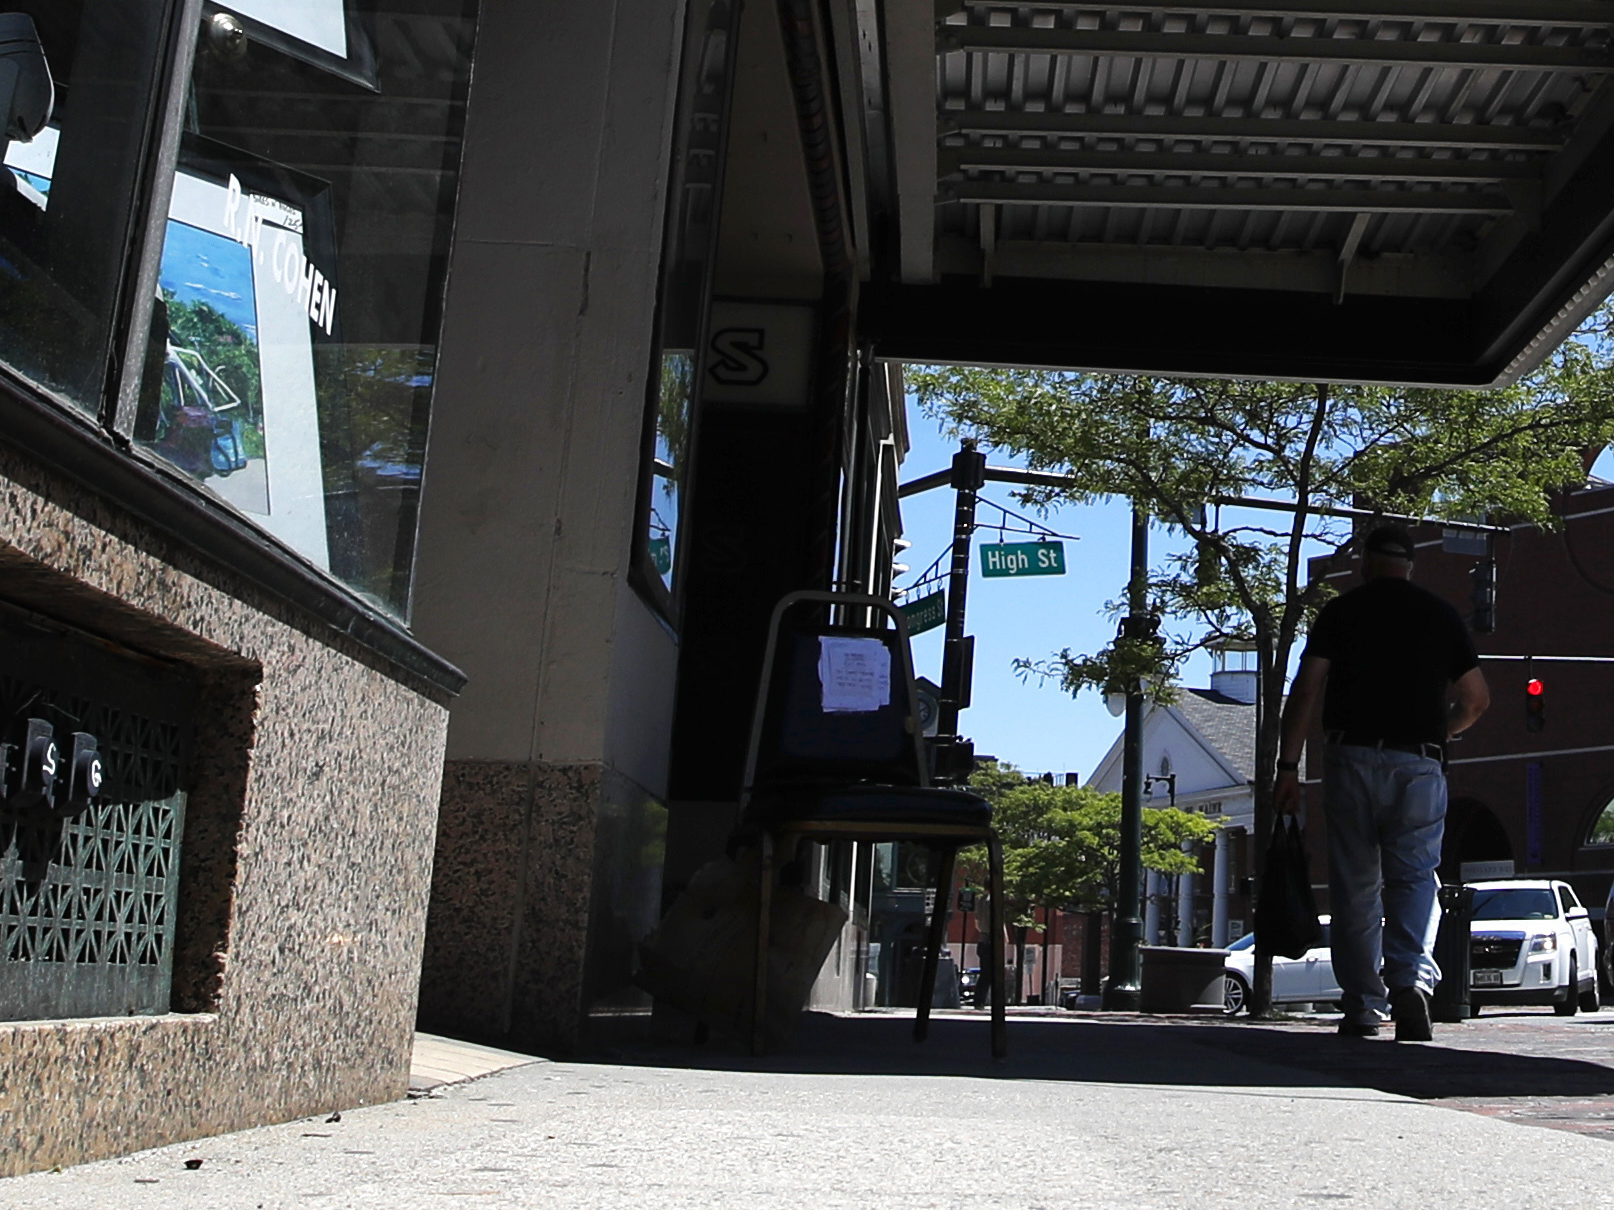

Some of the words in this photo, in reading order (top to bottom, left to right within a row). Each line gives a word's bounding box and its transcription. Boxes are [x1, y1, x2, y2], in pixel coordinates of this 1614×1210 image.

[272, 231, 337, 337] COHEN
[987, 549, 1029, 575] High
[1037, 547, 1058, 570] St
[905, 606, 936, 632] ongress
